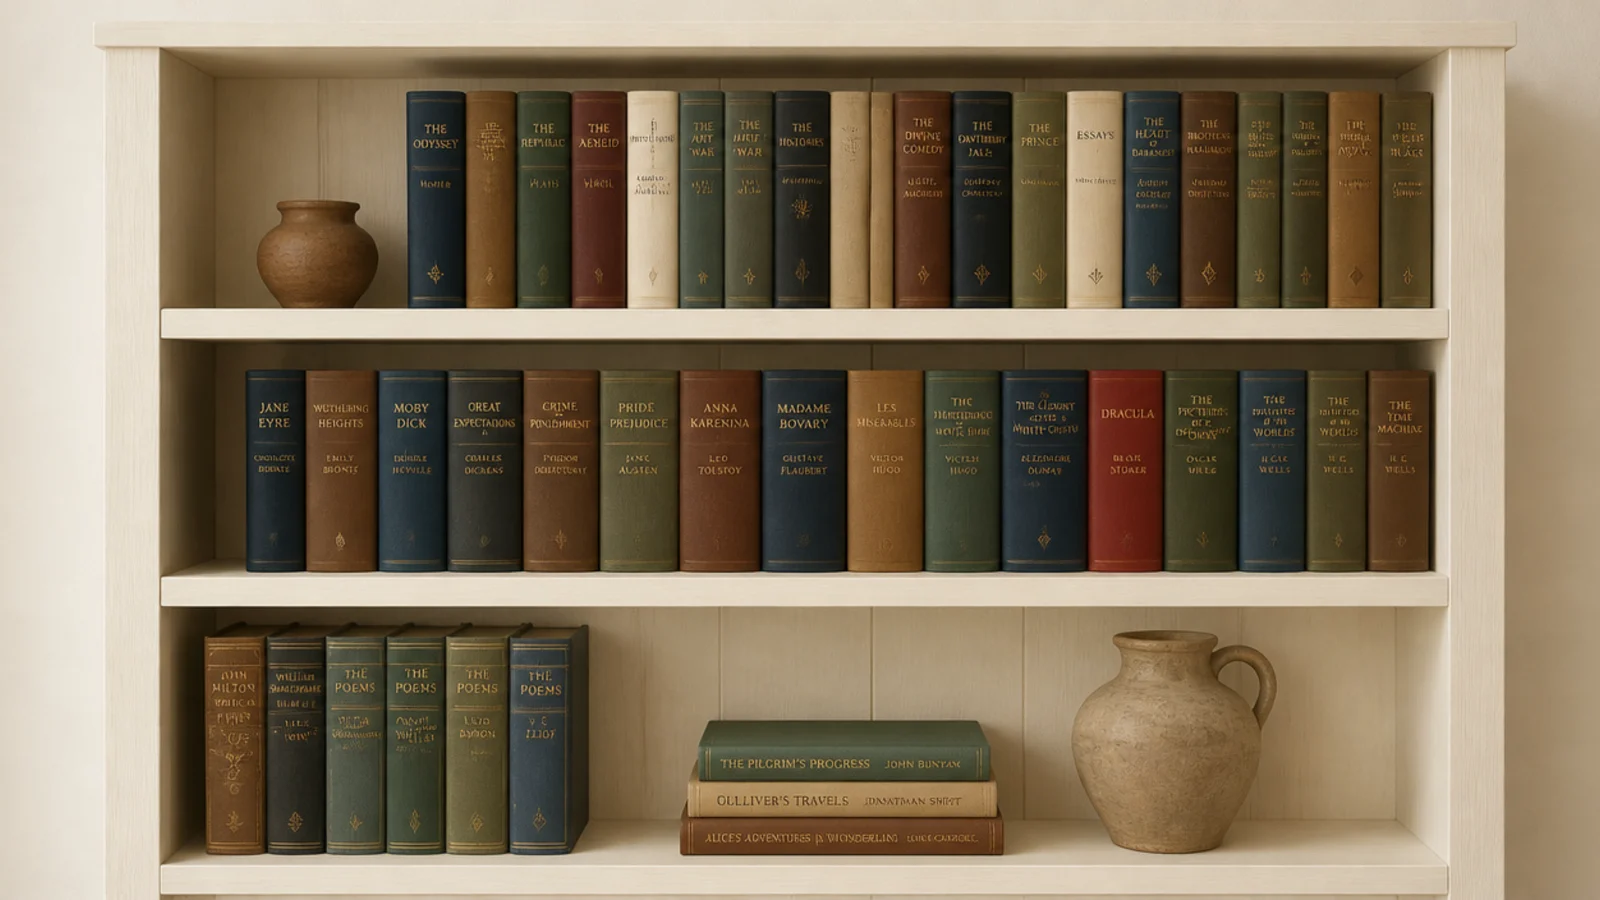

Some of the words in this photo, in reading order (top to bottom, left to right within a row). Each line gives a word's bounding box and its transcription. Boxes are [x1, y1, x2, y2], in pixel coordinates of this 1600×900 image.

[694, 122, 714, 131] THE
[739, 120, 760, 130] THE
[913, 118, 934, 127] THE
[973, 121, 992, 131] THE
[1144, 117, 1165, 126] THE
[424, 124, 447, 133] THE
[533, 123, 555, 133] THE
[588, 123, 610, 133] THE
[792, 123, 812, 132] THE
[1029, 124, 1050, 133] THE
[1077, 131, 1115, 140] ESSAYS
[1021, 138, 1059, 147] PRINCE
[1328, 397, 1349, 406] THE
[1388, 401, 1411, 410] THE
[260, 402, 289, 414] JANE
[394, 403, 430, 413] MOBY
[618, 402, 654, 413] PRIDE
[704, 404, 737, 413] ANNA
[777, 404, 831, 414] MADAME
[1101, 408, 1154, 419] DRACULA
[258, 418, 291, 428] EYRE
[318, 419, 364, 428] HEIGHTS
[397, 419, 427, 428] DICK
[690, 419, 750, 428] KARENINA
[779, 419, 828, 429] BOVARY
[345, 669, 368, 679] THE
[405, 668, 428, 679] THE
[465, 669, 490, 680] THE
[529, 670, 552, 681] THE
[335, 683, 376, 693] POEMS
[396, 683, 437, 693] POEMS
[457, 683, 498, 693] POEMS
[521, 685, 562, 696] POEMS
[720, 759, 744, 768] THE
[748, 759, 806, 768] PILGRIM'S
[810, 759, 870, 768] PROGRESS
[885, 760, 914, 768] JOHN
[794, 796, 849, 806] TRAVELS
